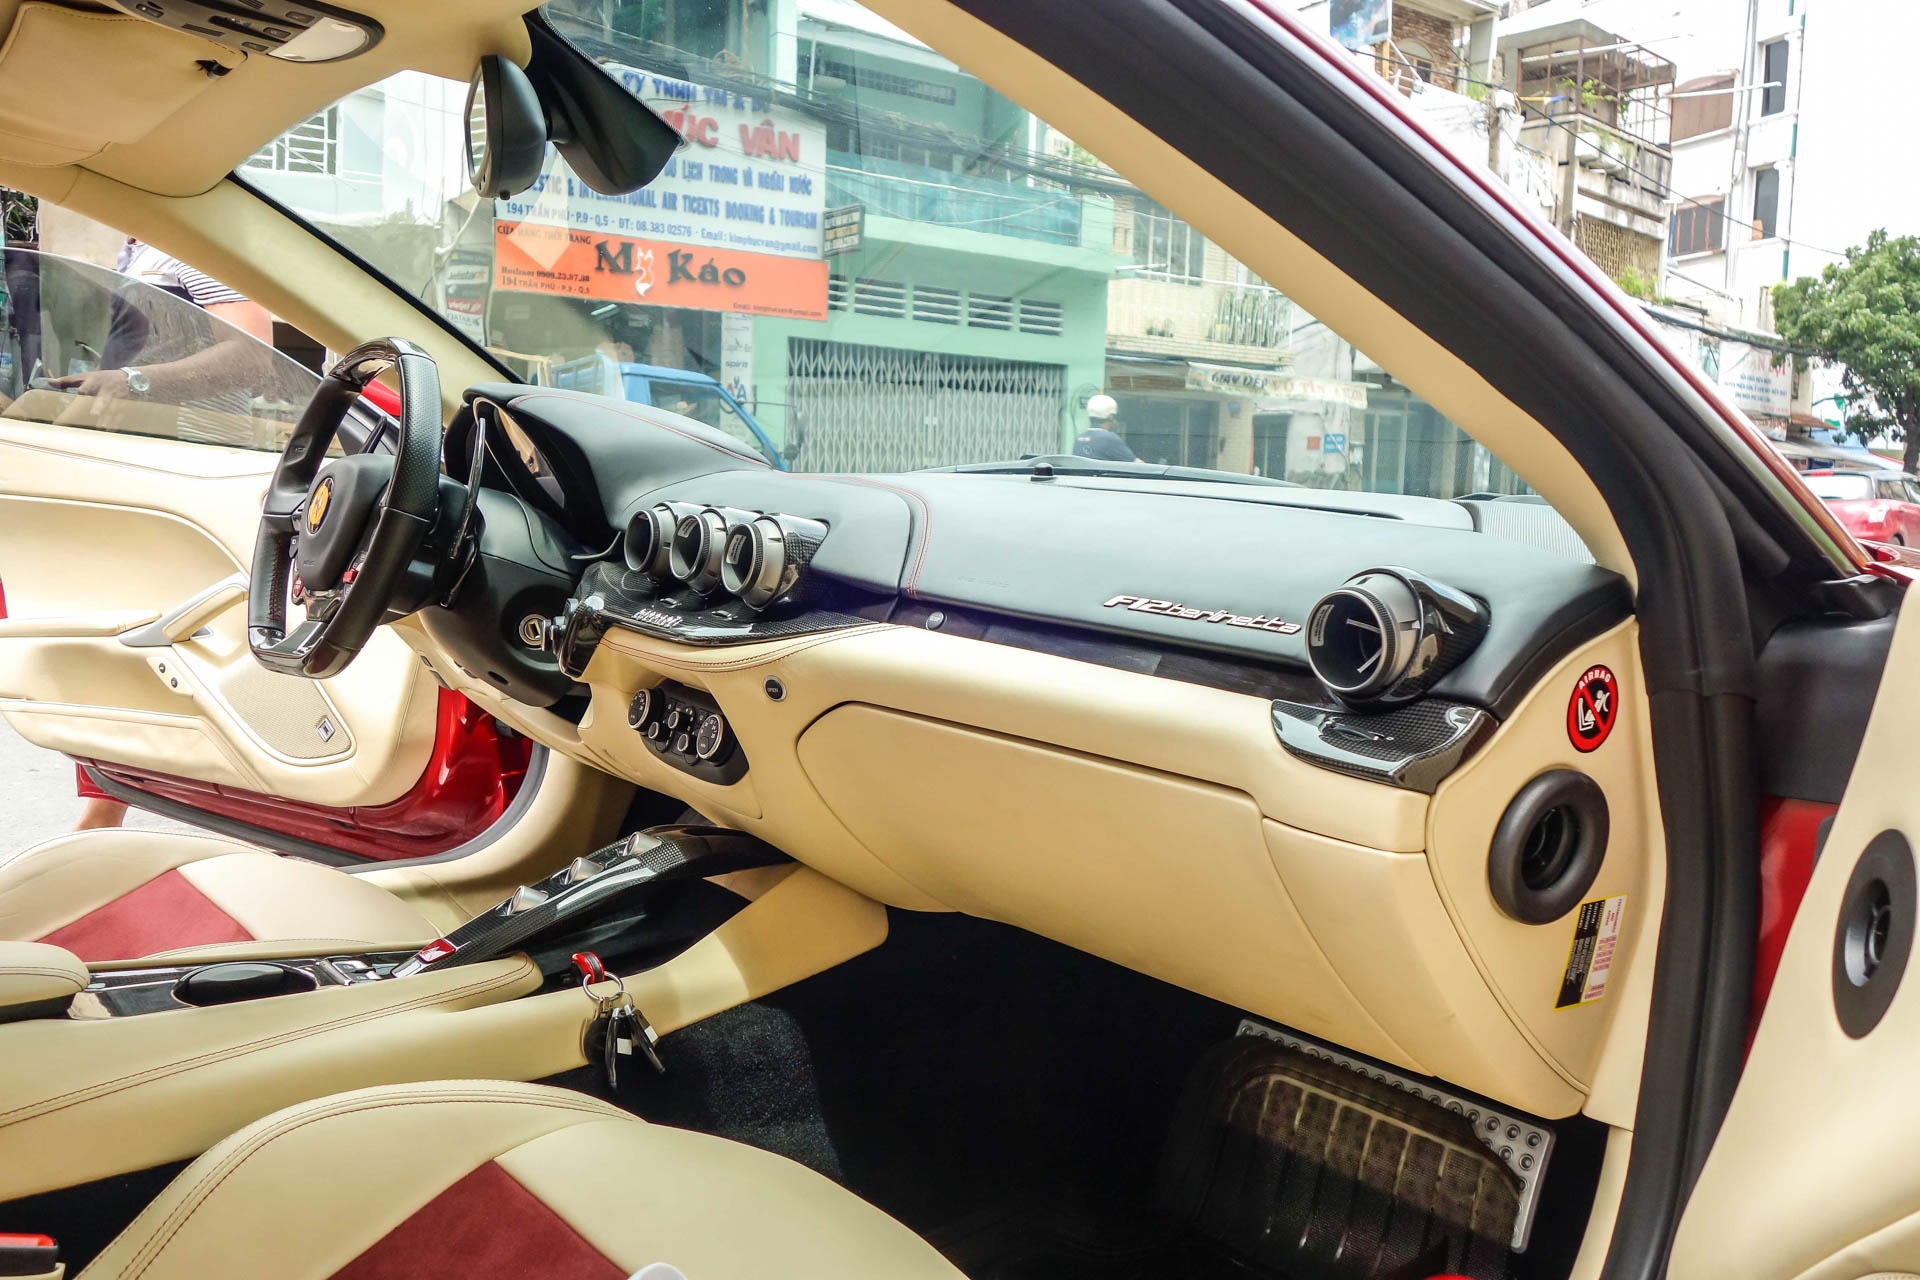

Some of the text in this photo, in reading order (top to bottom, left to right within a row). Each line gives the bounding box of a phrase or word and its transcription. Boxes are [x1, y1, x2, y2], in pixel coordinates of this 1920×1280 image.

[652, 77, 697, 100] TNHH
[663, 104, 800, 162] ÚC VÂN
[682, 159, 703, 182] LỊCH
[709, 164, 738, 185] TRONG
[506, 202, 523, 215] 194
[576, 211, 588, 224] P.9
[595, 214, 609, 227] Q.5
[667, 225, 692, 238] 02576
[662, 191, 677, 211] AIR
[725, 201, 765, 224] BOOKING
[769, 207, 776, 225] &
[780, 208, 818, 230] TOURISM
[667, 248, 746, 287] Káo
[1579, 669, 1611, 690] AIRBAG
